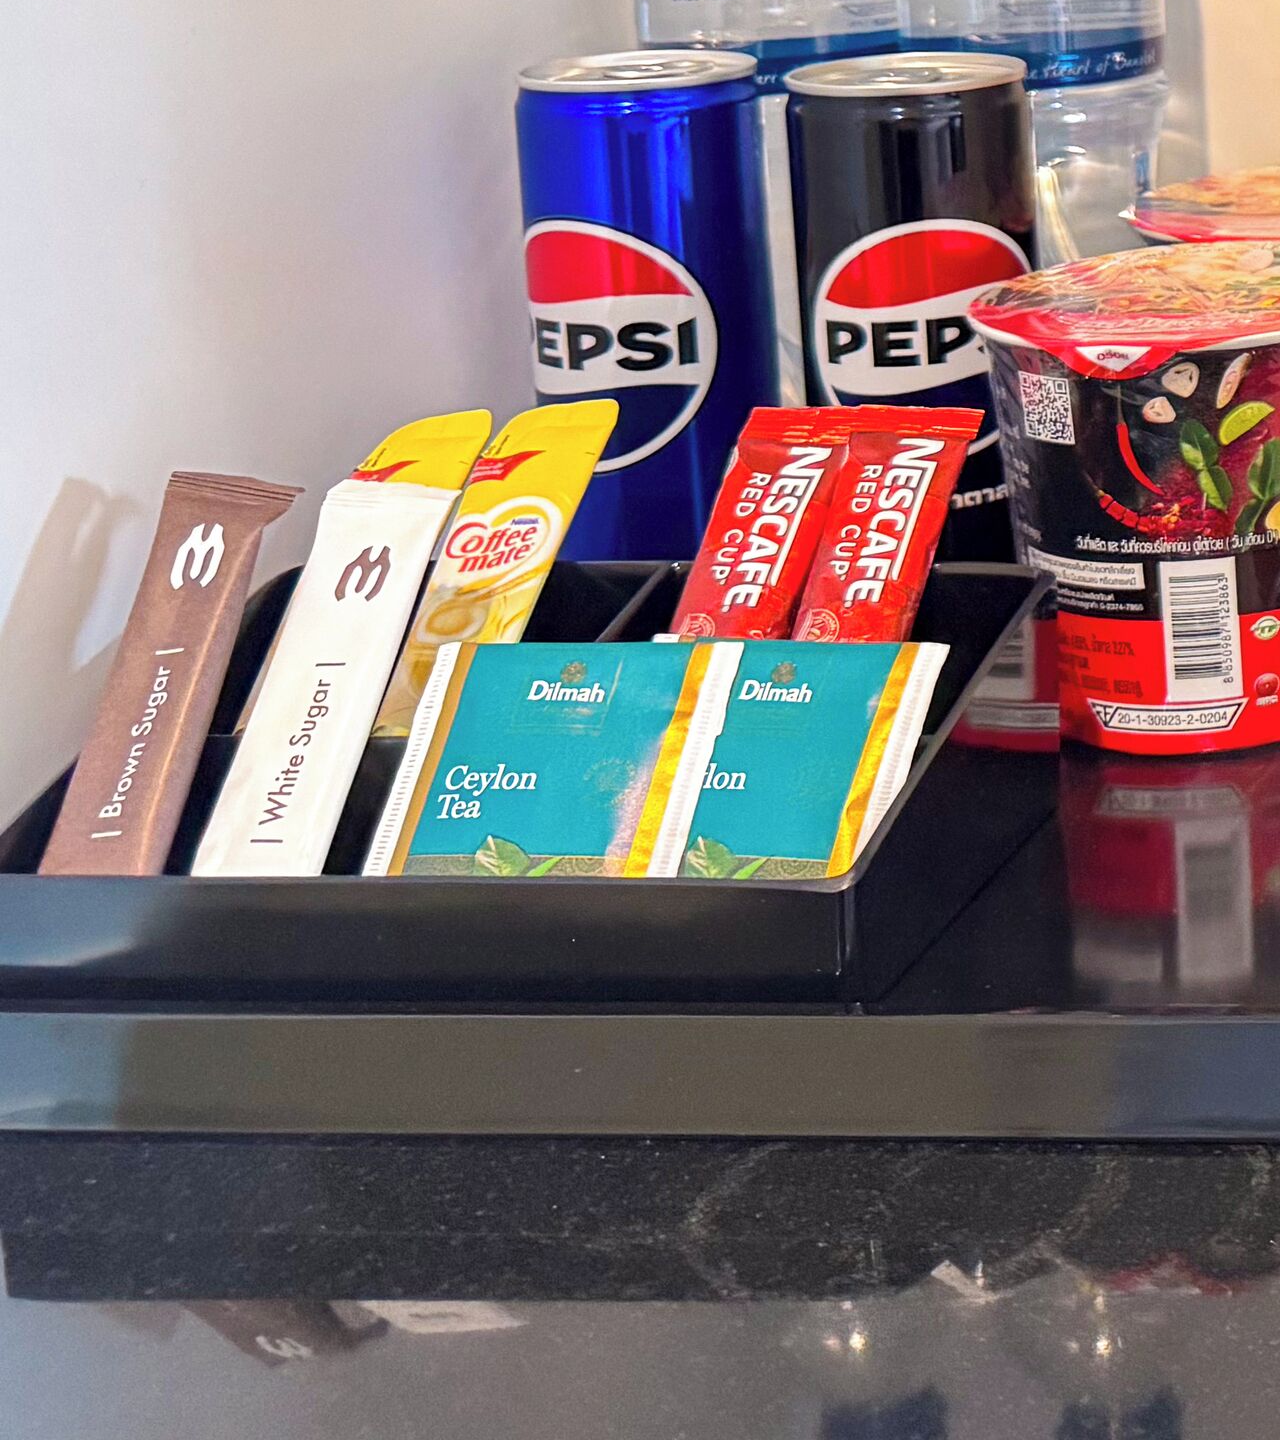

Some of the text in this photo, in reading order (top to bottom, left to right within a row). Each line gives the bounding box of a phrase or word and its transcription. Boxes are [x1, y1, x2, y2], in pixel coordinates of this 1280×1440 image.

[531, 317, 700, 370] EPSI
[826, 316, 986, 366] PEP
[445, 521, 537, 558] Coffee
[711, 471, 772, 580] RED CUP
[830, 464, 883, 577] RED CUP
[458, 544, 531, 572] mate
[527, 680, 606, 704] Dilmah
[738, 679, 813, 704] Dilmah
[98, 665, 171, 818] Brown Sugar
[258, 679, 332, 826] White Sugar
[444, 764, 537, 795] Ceylon
[436, 794, 481, 820] Tea
